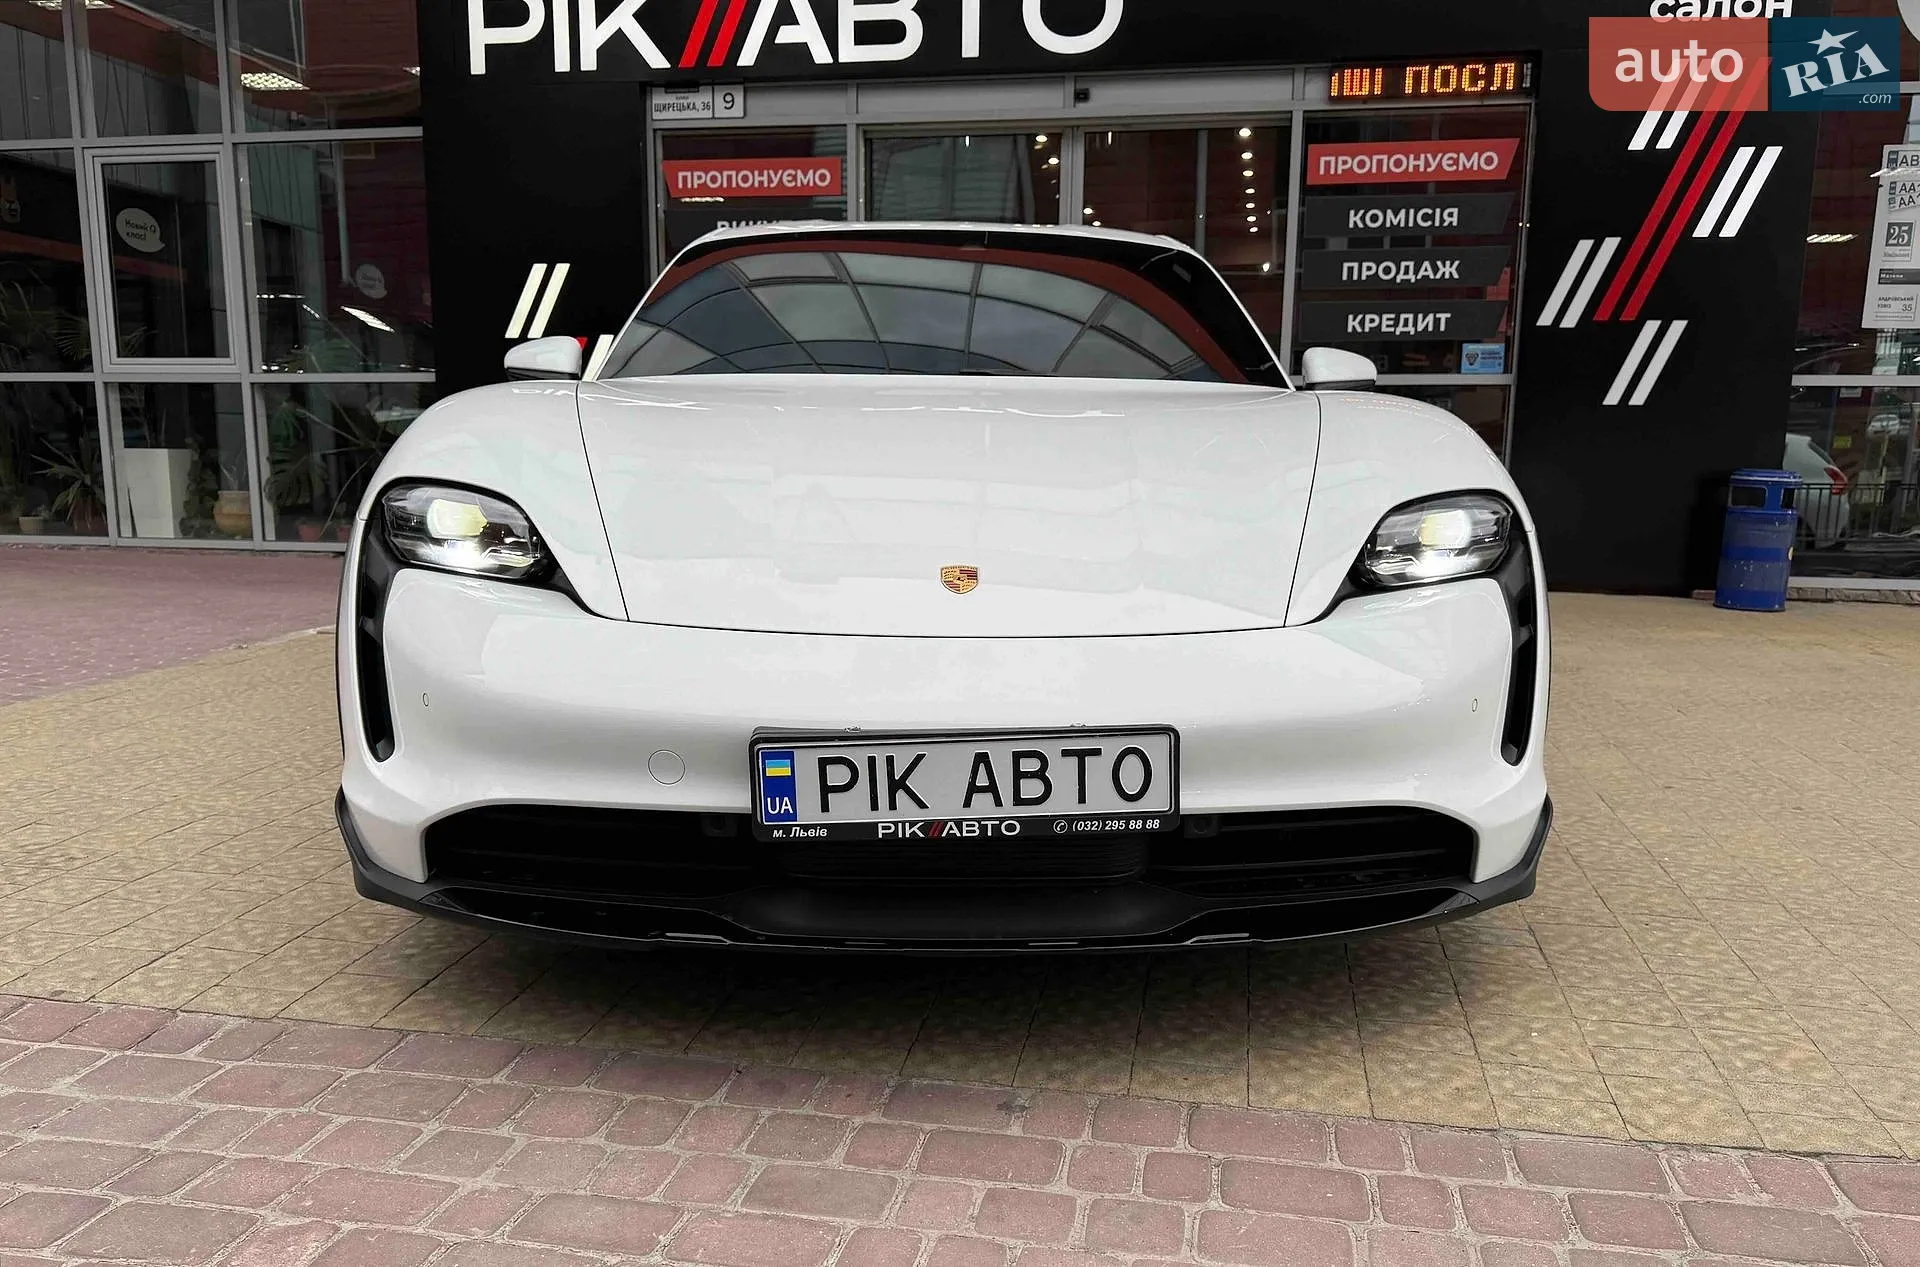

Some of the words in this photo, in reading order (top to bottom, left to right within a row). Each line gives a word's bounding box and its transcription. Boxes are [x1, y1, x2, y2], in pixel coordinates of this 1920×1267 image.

[722, 92, 735, 110] 9
[1319, 151, 1499, 175] ПРОПОНУЄМО
[678, 168, 832, 189] ПРОПОНУЄМО
[1349, 207, 1459, 229] КОМІСІЯ
[1888, 225, 1909, 244] 25
[1341, 260, 1460, 283] ПРОДАЖ
[1347, 312, 1451, 335] КРЕДИТ
[818, 753, 930, 813] РІК
[962, 746, 1153, 809] АВТО
[767, 797, 793, 814] UA
[772, 828, 786, 838] м.
[790, 826, 828, 838] Львів
[1072, 820, 1102, 831] (032)
[1105, 820, 1126, 830] 295
[1128, 820, 1143, 830] 88
[1145, 819, 1160, 830] 88
